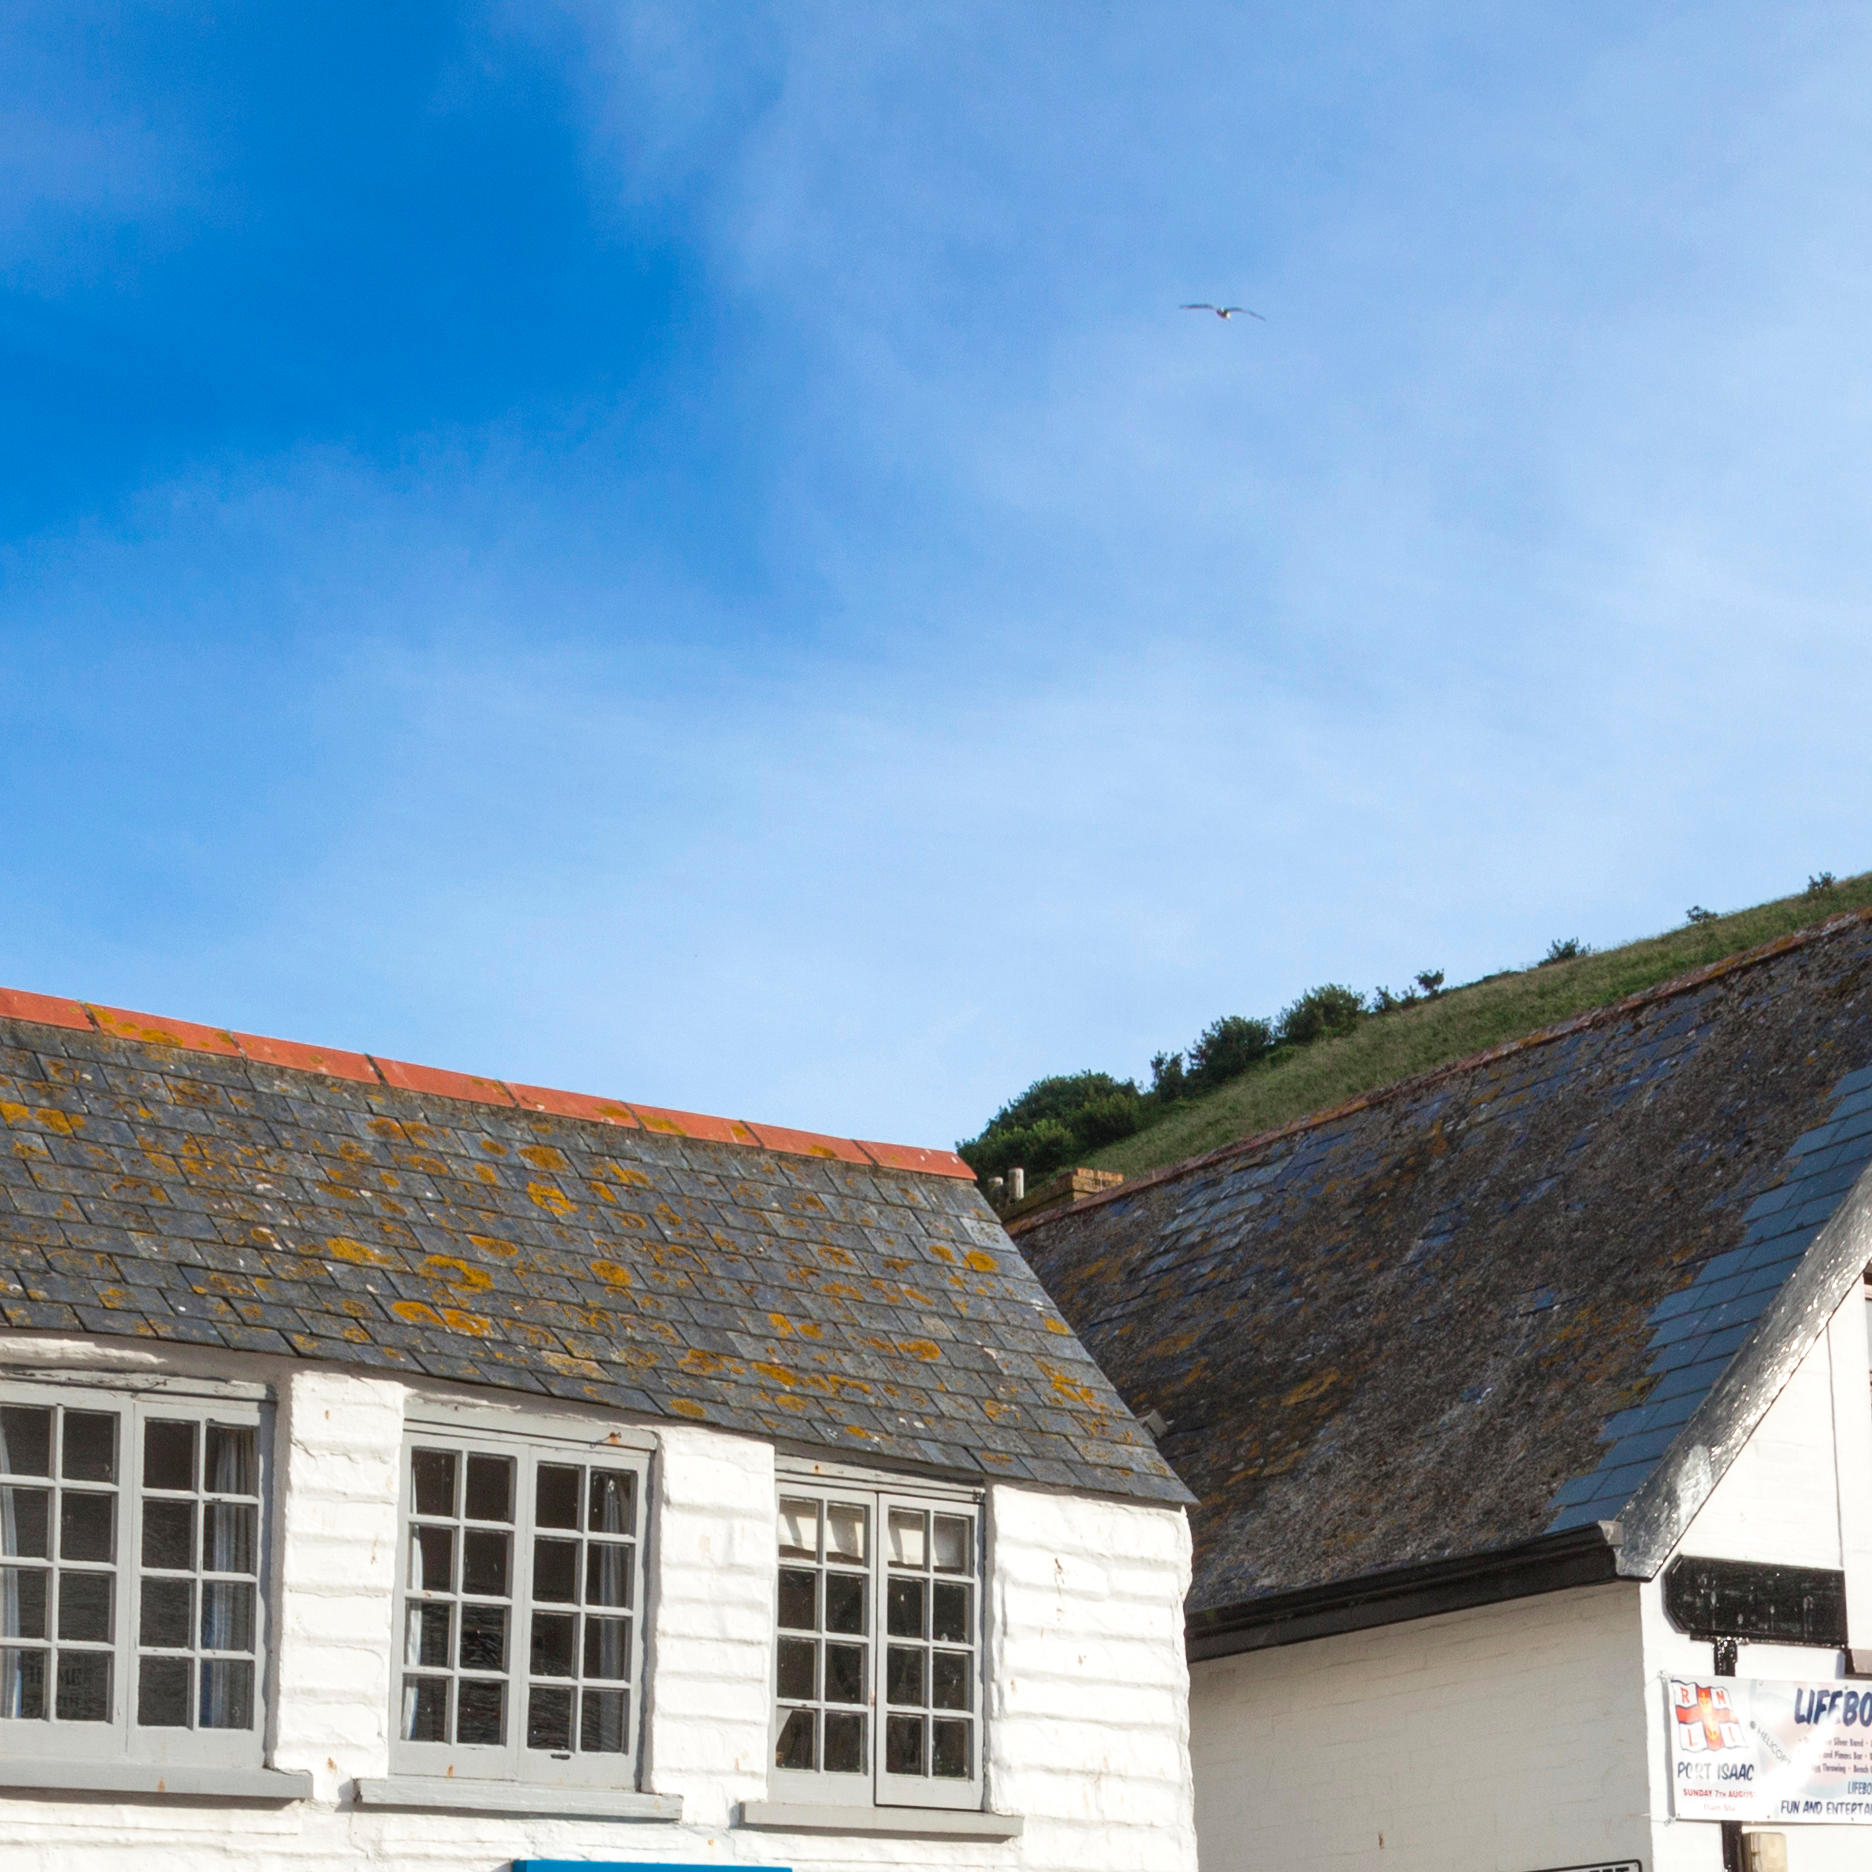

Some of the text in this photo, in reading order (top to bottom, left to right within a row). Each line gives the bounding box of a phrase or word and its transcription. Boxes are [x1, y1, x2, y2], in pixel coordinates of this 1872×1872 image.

[1717, 1762, 1754, 1781] ISAAC
[1683, 1788, 1713, 1797] SUNDAY
[1781, 1800, 1800, 1814] FUN
[1803, 1801, 1822, 1814] AND
